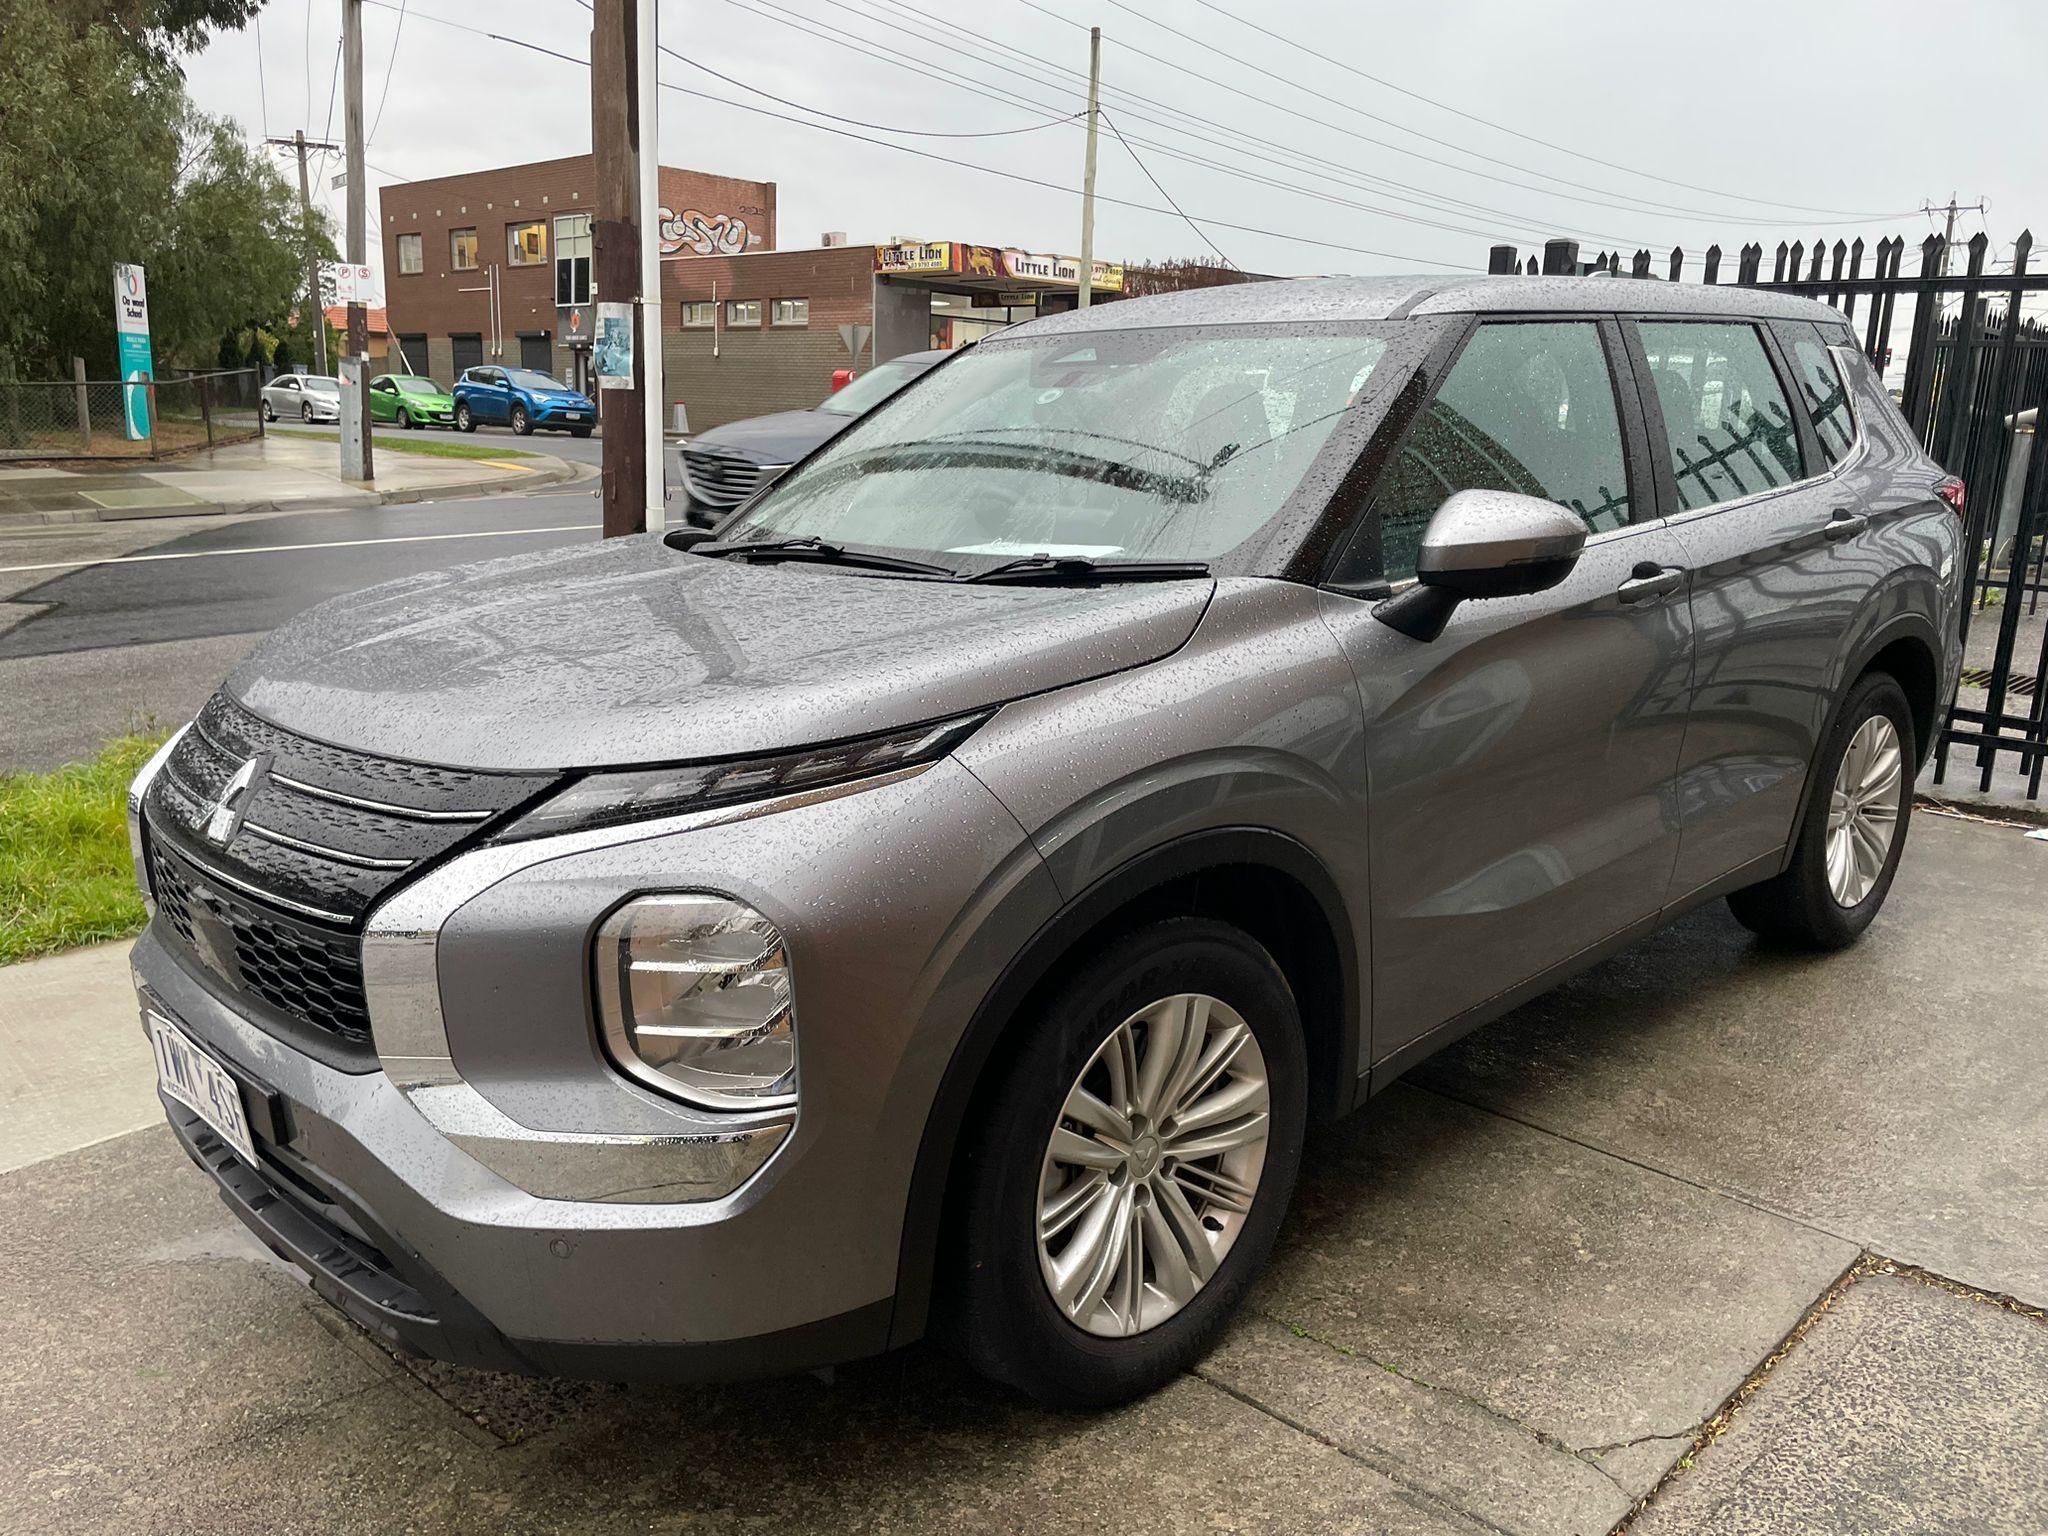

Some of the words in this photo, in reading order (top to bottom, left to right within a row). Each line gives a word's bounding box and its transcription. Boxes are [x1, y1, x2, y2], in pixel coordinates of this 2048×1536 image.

[919, 246, 942, 260] LION
[1015, 258, 1048, 276] LITTLE
[1053, 262, 1075, 279] LION
[127, 308, 143, 319] School
